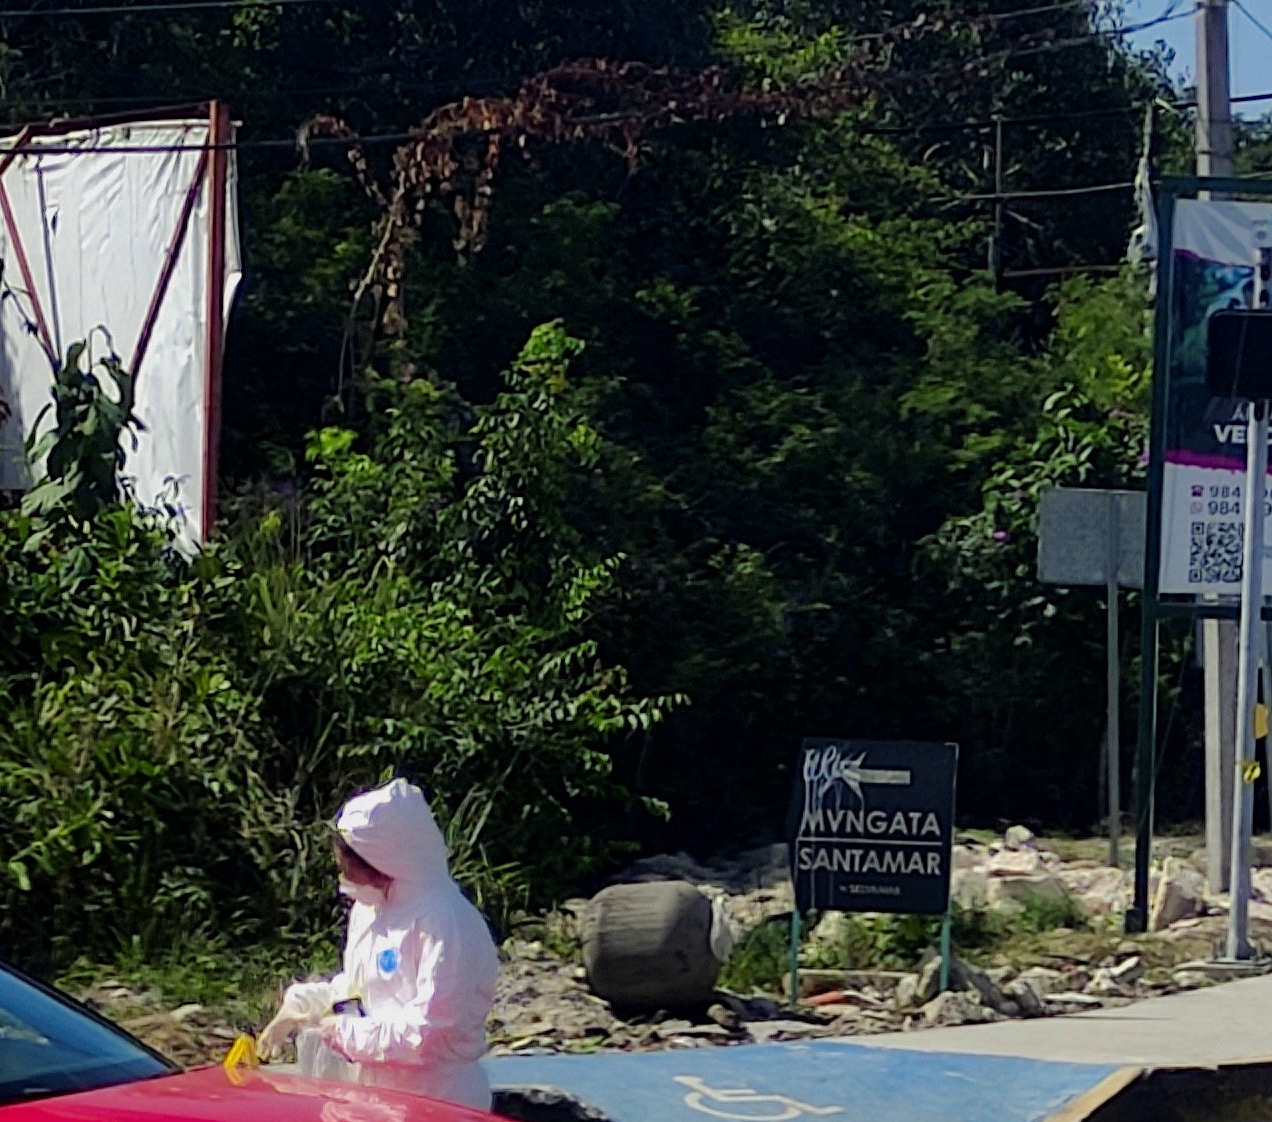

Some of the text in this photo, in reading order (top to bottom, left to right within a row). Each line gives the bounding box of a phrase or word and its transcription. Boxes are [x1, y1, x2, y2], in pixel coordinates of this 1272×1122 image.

[1209, 485, 1241, 499] 984
[1208, 500, 1241, 516] 984
[800, 808, 941, 837] MVNGATA
[799, 847, 942, 876] SANTAMAR
